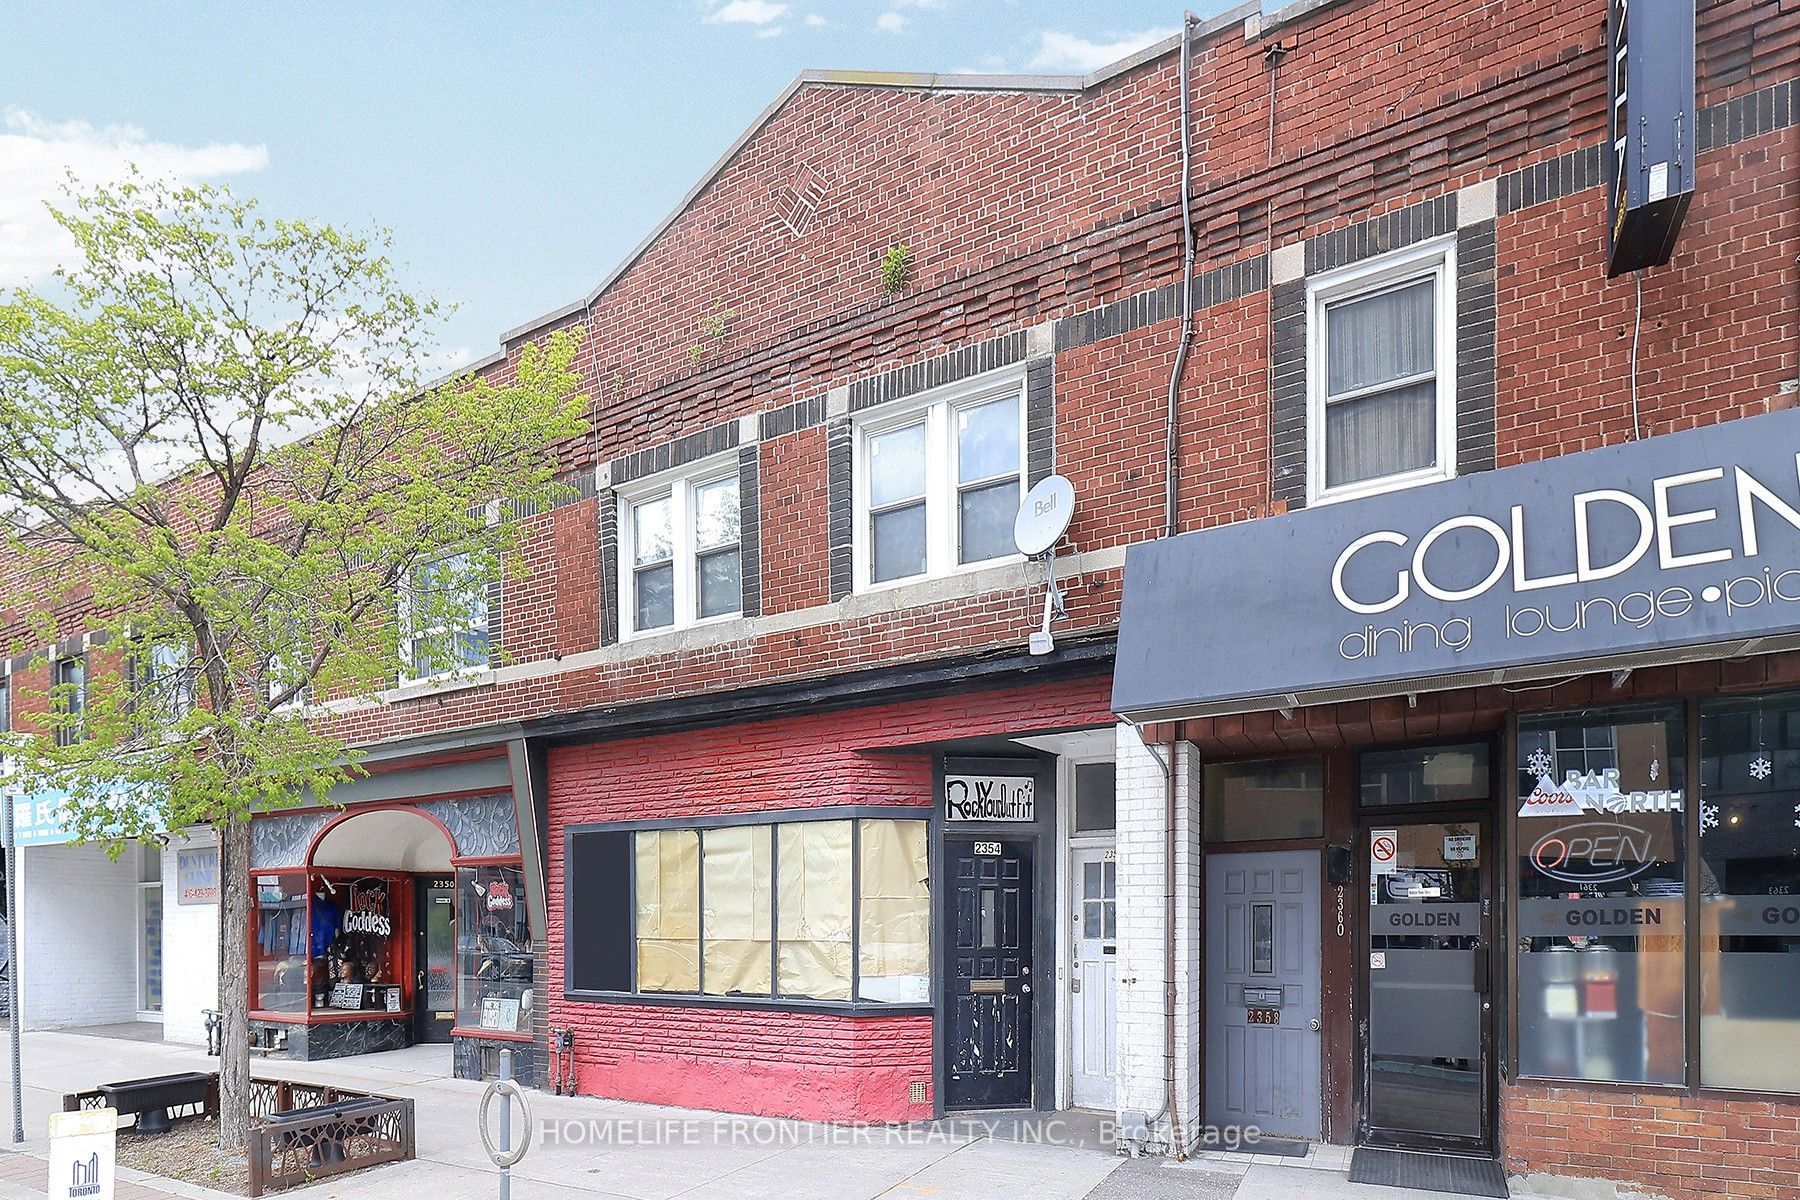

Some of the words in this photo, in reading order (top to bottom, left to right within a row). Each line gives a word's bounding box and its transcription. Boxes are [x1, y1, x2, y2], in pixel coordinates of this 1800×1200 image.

[1034, 492, 1057, 518] Bell
[1331, 452, 1800, 614] GOLDEN
[1339, 616, 1472, 660] dining
[1566, 768, 1620, 790] BAR
[1526, 787, 1573, 806] Coors
[975, 842, 1001, 854] 2354
[1536, 834, 1652, 868] OPEN
[433, 880, 455, 888] 2350
[1337, 885, 1345, 937] 2360
[1389, 912, 1460, 927] GOLDEN
[1566, 908, 1661, 926] GOLDEN
[344, 909, 391, 936] Goddess
[1248, 1010, 1279, 1024] 2358
[69, 1184, 101, 1198] TORONTO
